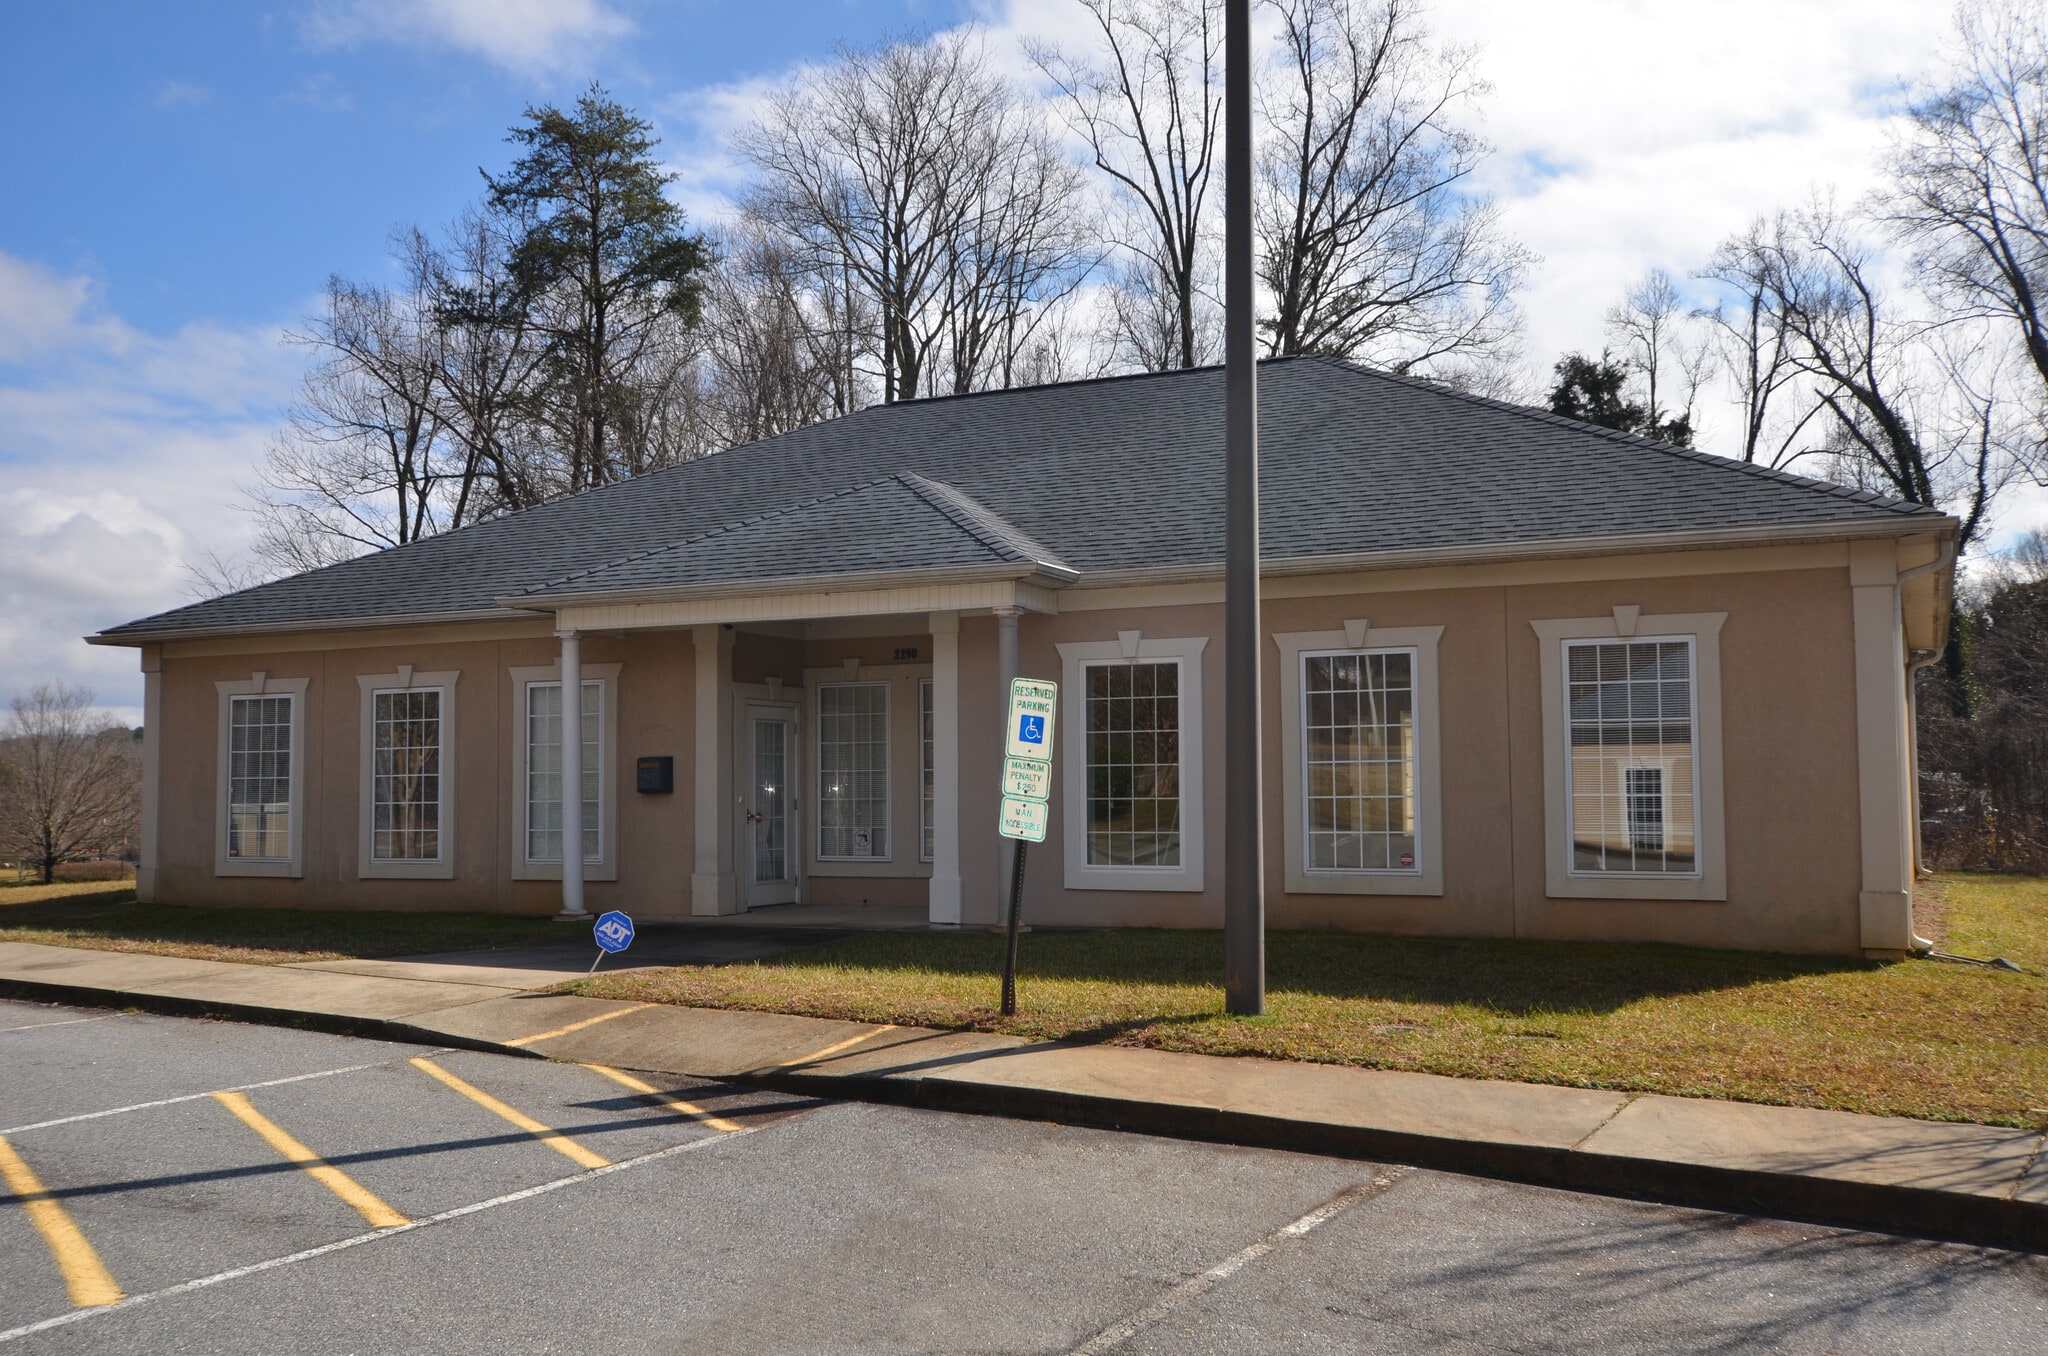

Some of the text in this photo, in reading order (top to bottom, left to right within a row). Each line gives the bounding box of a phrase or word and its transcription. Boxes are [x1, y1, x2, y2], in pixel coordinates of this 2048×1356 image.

[1014, 686, 1054, 699] RESERVED
[1016, 701, 1050, 713] PARKING
[1012, 762, 1044, 772] MAXIMUM
[1010, 771, 1042, 782] PENALTY
[1015, 808, 1033, 817] VAN
[1005, 819, 1041, 831] ACCESSIBLE
[598, 920, 630, 943] ADT
